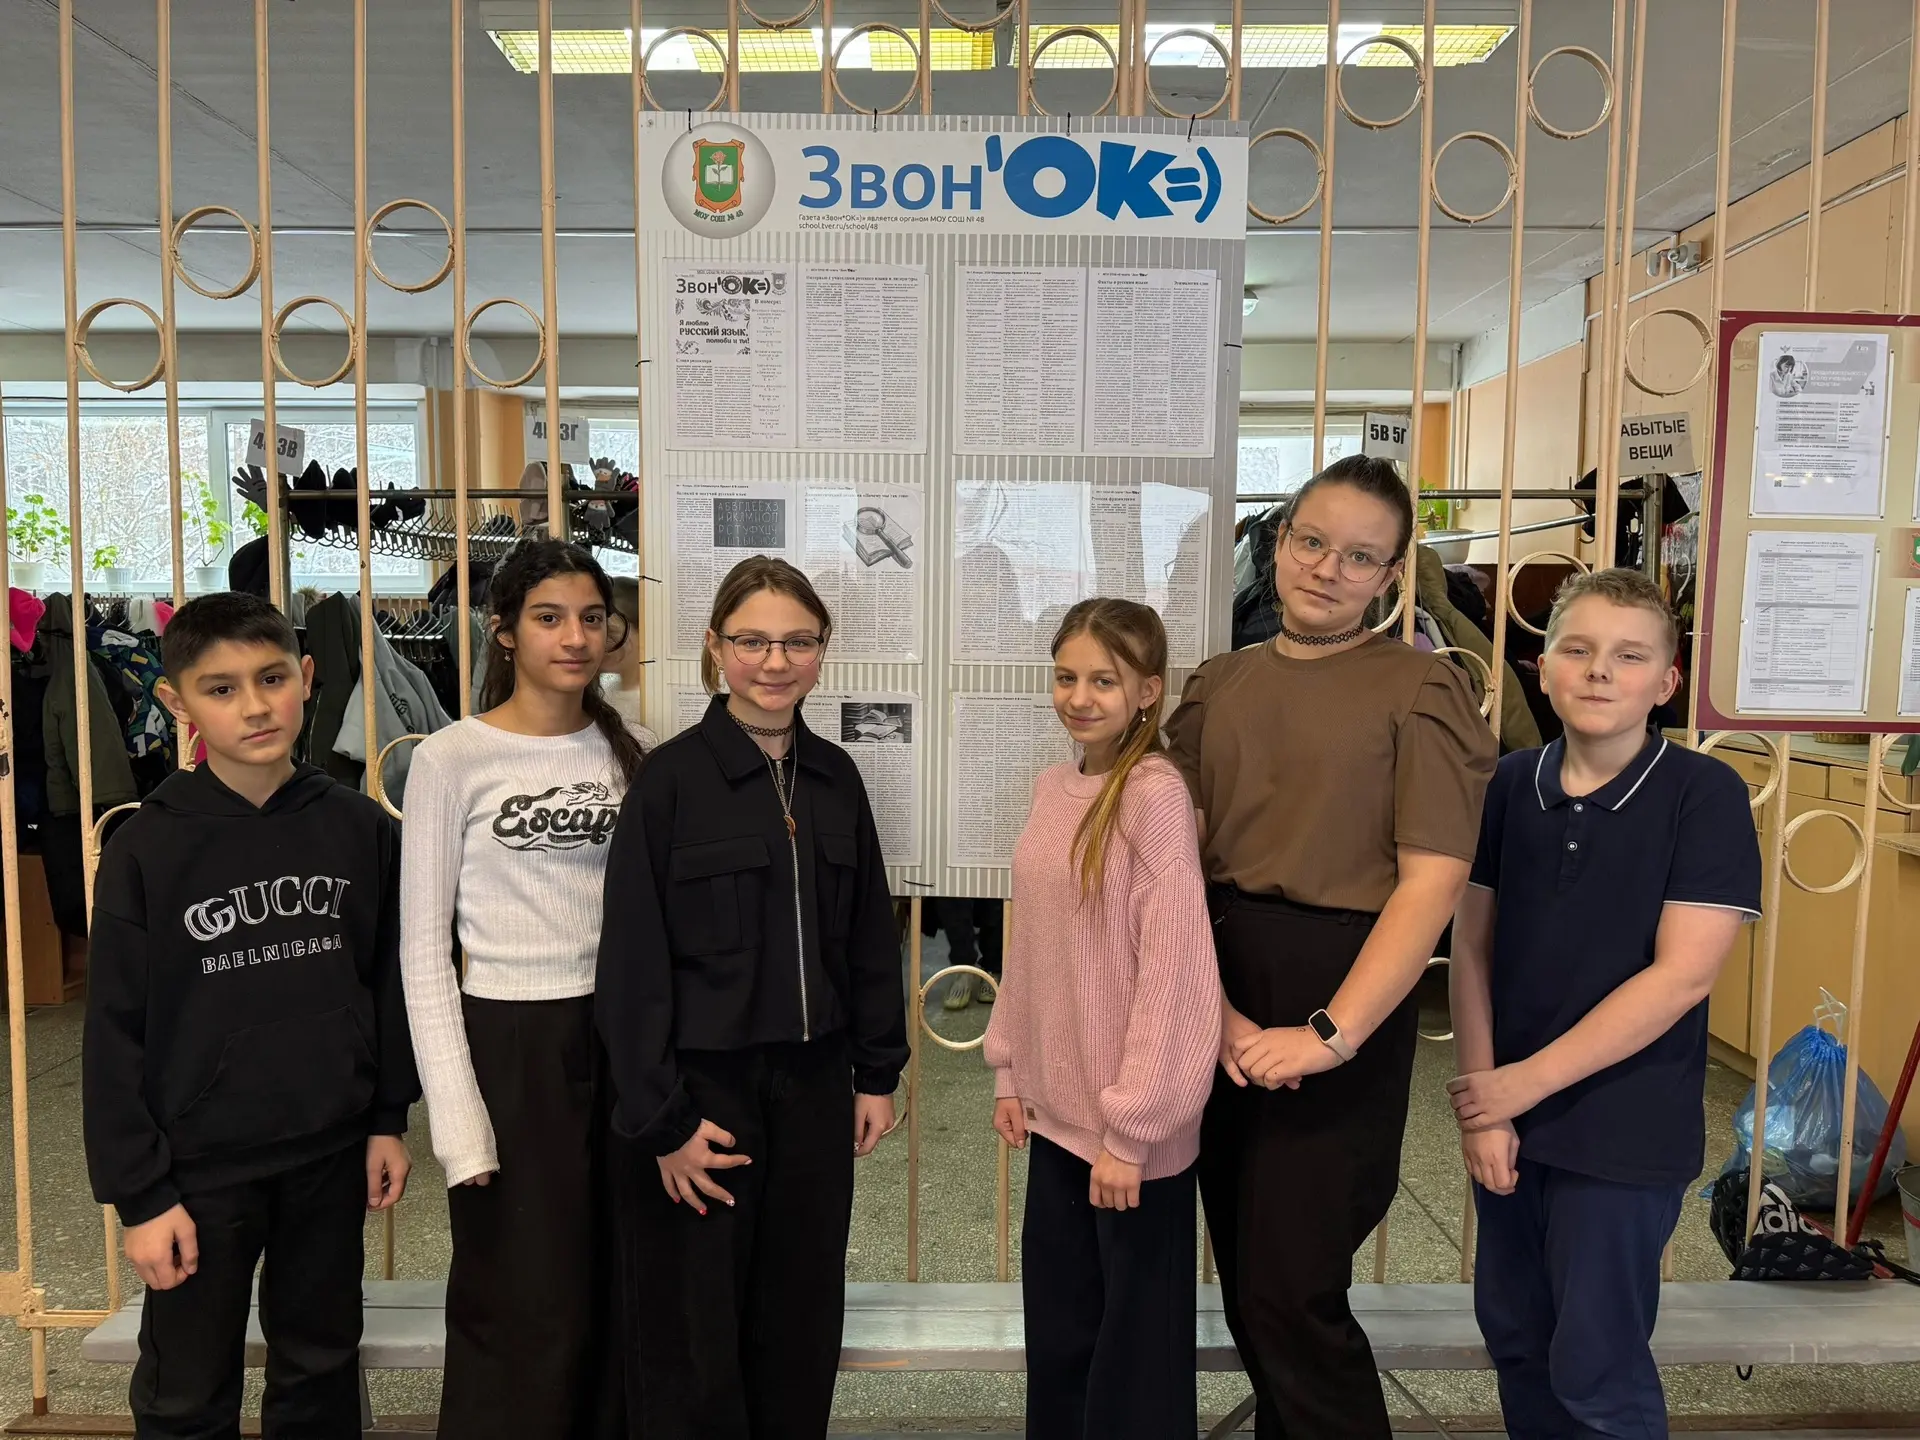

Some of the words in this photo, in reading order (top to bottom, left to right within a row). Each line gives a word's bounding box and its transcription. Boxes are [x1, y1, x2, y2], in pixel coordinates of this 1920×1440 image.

[693, 209, 710, 221] МОУ
[710, 214, 726, 222] СОШ
[727, 212, 736, 221] №
[735, 209, 744, 217] 48
[798, 214, 820, 222] Газета
[900, 216, 928, 224] органом
[948, 215, 965, 223] СОШ
[966, 215, 976, 223] №
[798, 222, 878, 231] school.tver.ru/school/48
[680, 326, 719, 336] РУССКИЙ
[532, 422, 547, 439] 4
[560, 422, 579, 442] 3Г
[1370, 424, 1389, 442] 5В
[1392, 426, 1407, 444] 5Г
[1620, 419, 1686, 438] АБЫТЫЕ
[253, 432, 266, 451] 4
[277, 438, 298, 458] 3В
[1629, 444, 1673, 460] ВЕЩИ
[492, 786, 618, 845] Escap
[184, 876, 350, 942] GUCCI
[202, 934, 342, 974] BAELNICAGA
